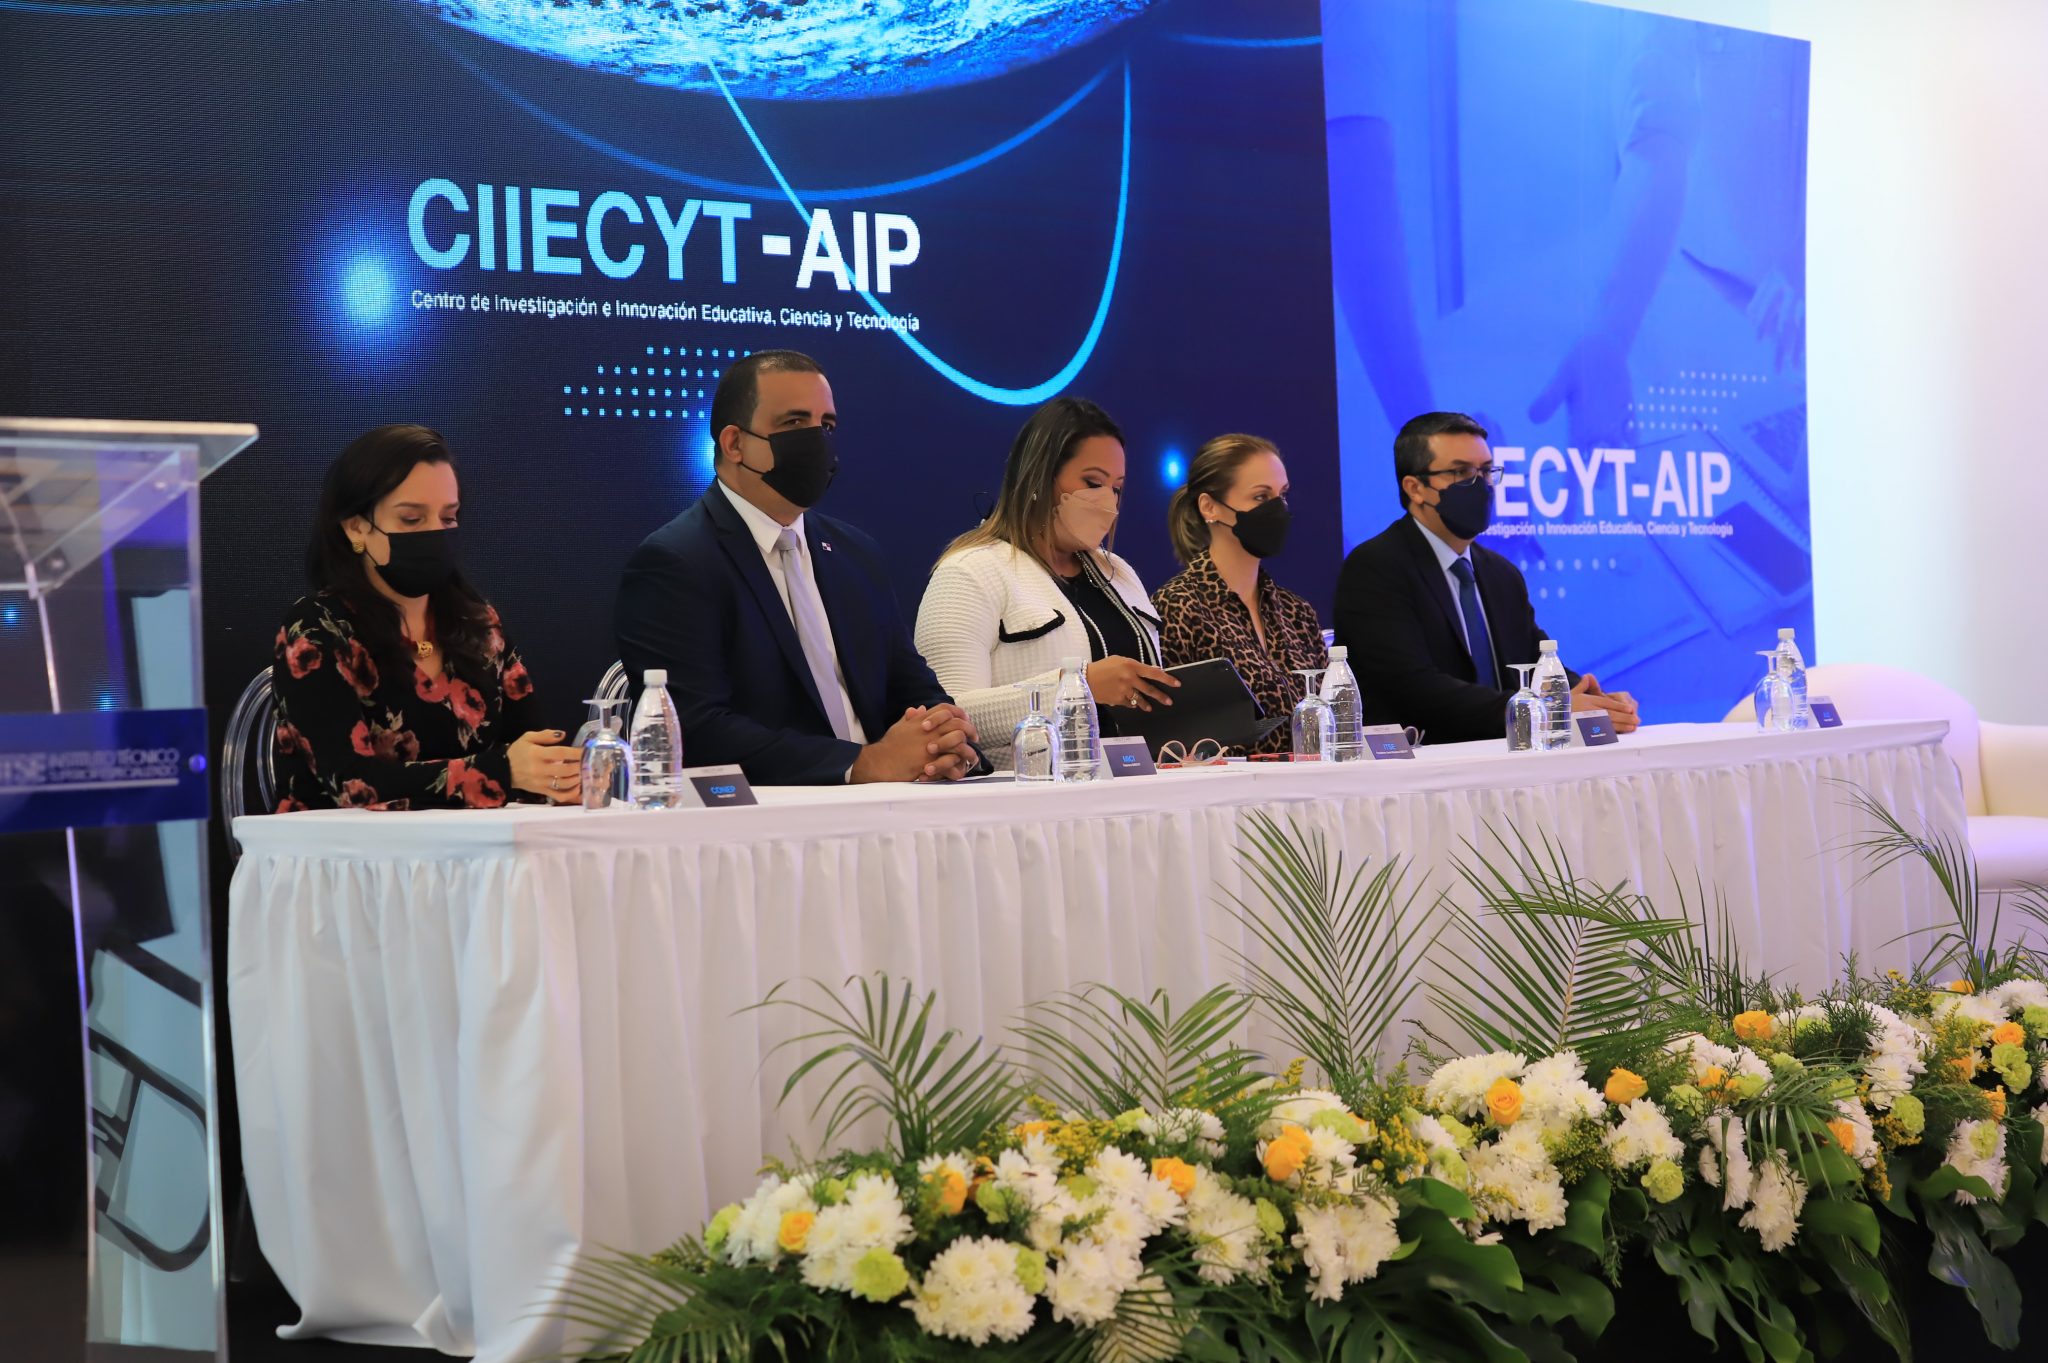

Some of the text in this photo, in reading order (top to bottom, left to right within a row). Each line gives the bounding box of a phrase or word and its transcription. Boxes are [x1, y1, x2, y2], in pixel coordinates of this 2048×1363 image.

[411, 290, 920, 334] Centro de Investigación e Innovación Educativa, Ciencia y Tecnología
[1492, 446, 1732, 518] ECYT-AIP
[1538, 523, 1544, 535] e
[1546, 520, 1598, 536] Innovación
[1599, 520, 1646, 537] Educativa,
[1647, 521, 1680, 536] Ciencia
